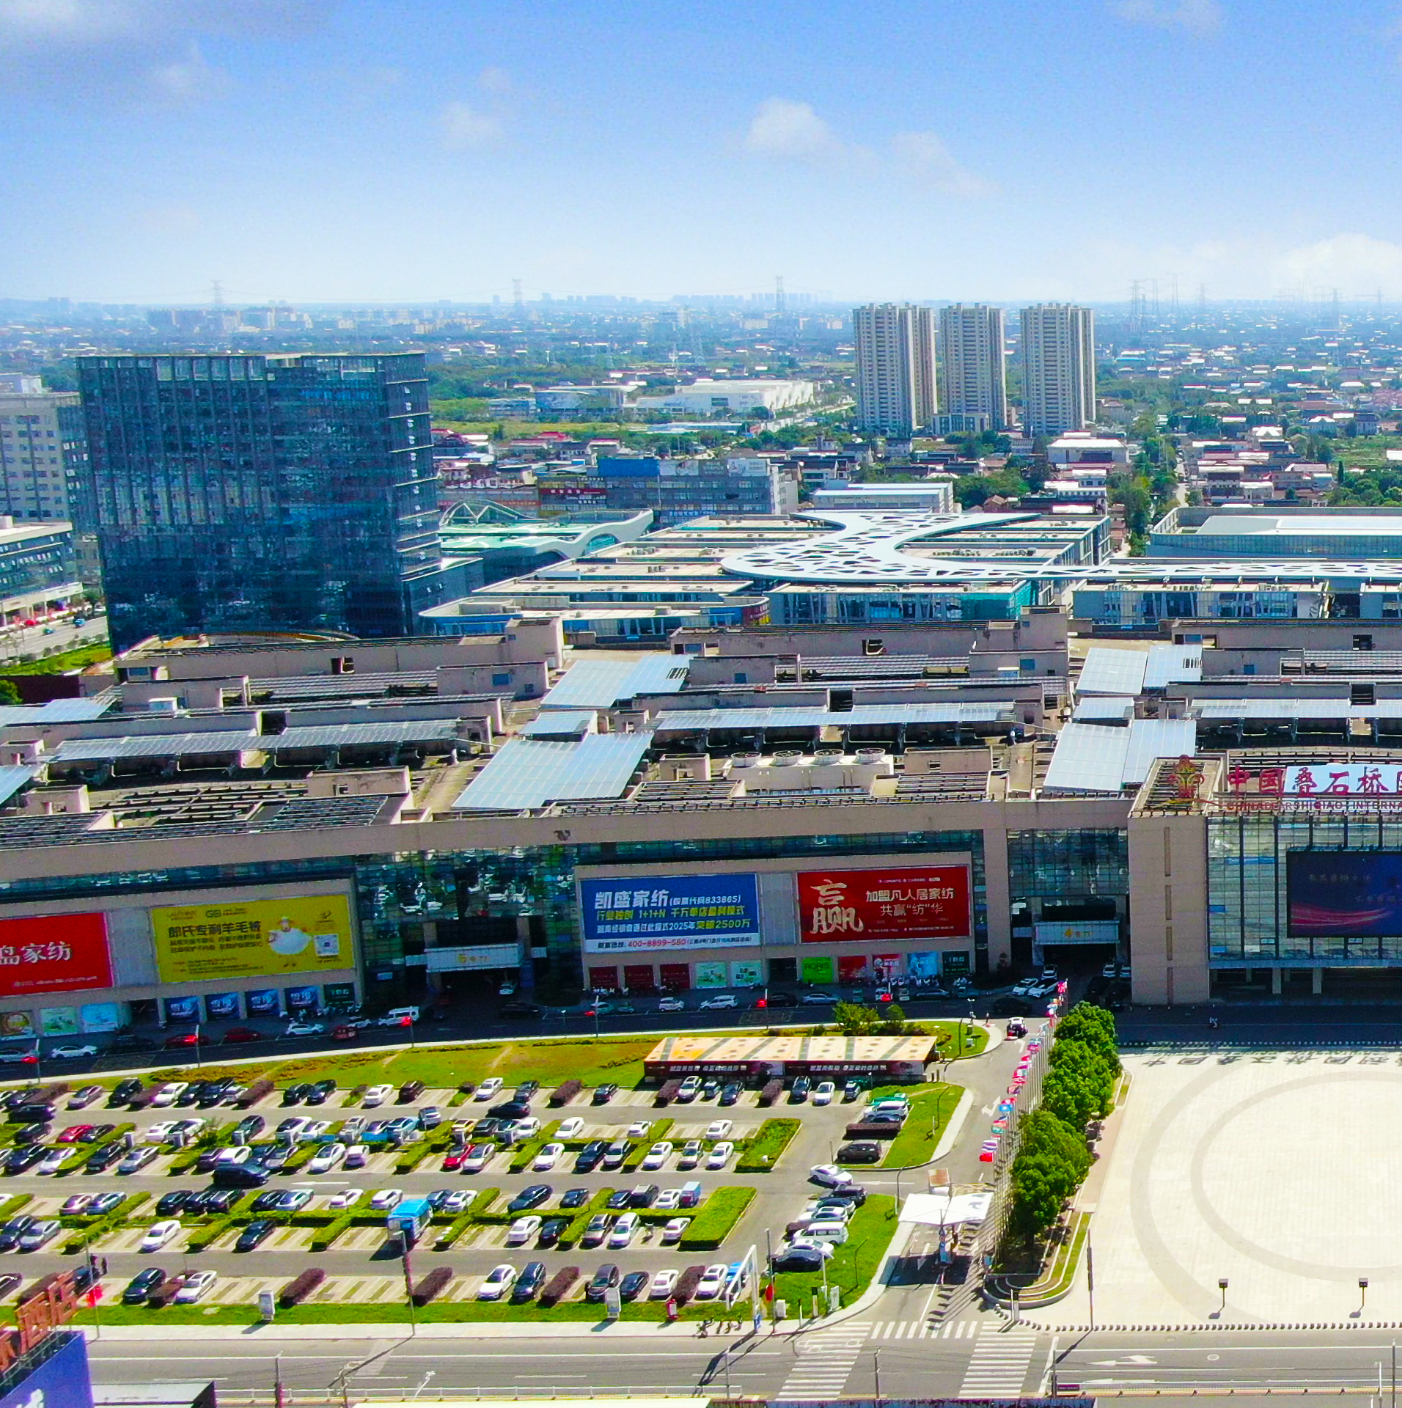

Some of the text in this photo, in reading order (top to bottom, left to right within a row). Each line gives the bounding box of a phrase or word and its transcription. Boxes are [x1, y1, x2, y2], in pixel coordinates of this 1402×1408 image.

[594, 889, 669, 909] 凯盛家纺
[810, 879, 864, 934] 赢
